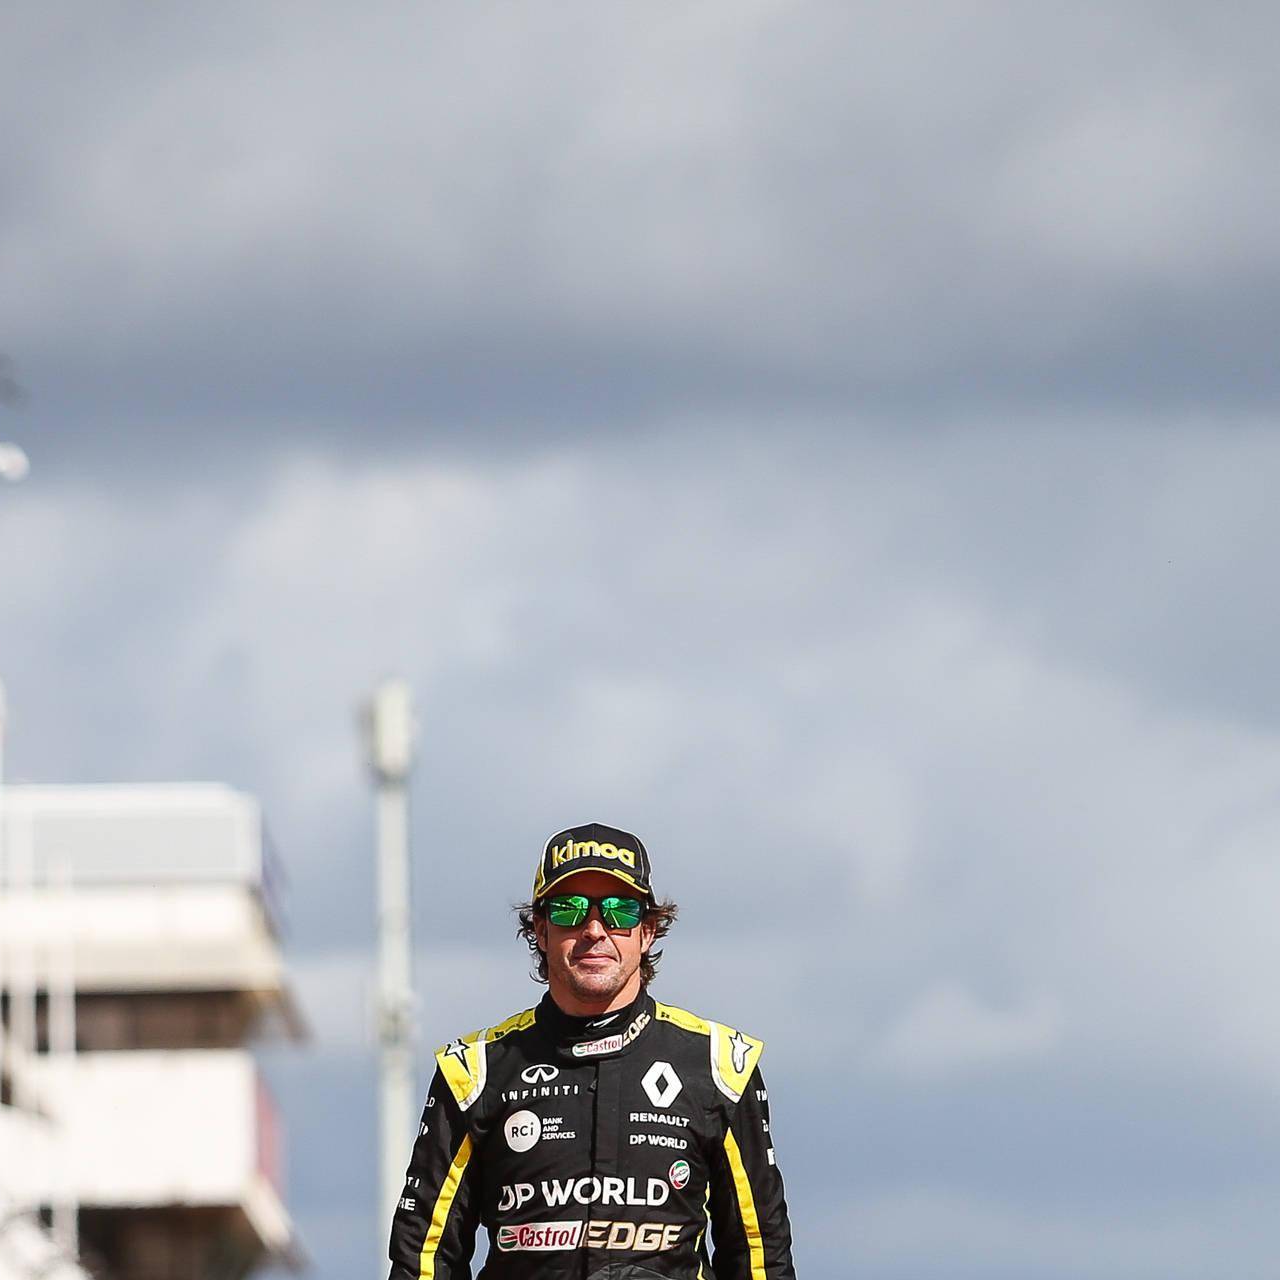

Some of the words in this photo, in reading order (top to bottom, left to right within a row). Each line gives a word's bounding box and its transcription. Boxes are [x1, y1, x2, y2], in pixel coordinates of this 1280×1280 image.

[551, 839, 635, 869] kimoa
[586, 1034, 621, 1053] Castrol
[501, 1085, 579, 1102] INFINITI
[542, 1117, 563, 1125] BANK
[629, 1112, 690, 1127] RENAULT
[511, 1122, 534, 1138] RCi
[542, 1125, 559, 1133] AND
[542, 1131, 576, 1141] SERVICES
[629, 1134, 646, 1146] DP
[647, 1135, 688, 1150] WORLD
[541, 1176, 670, 1208] WORLD
[518, 1225, 578, 1248] Castrol
[587, 1220, 685, 1252] EDGE
